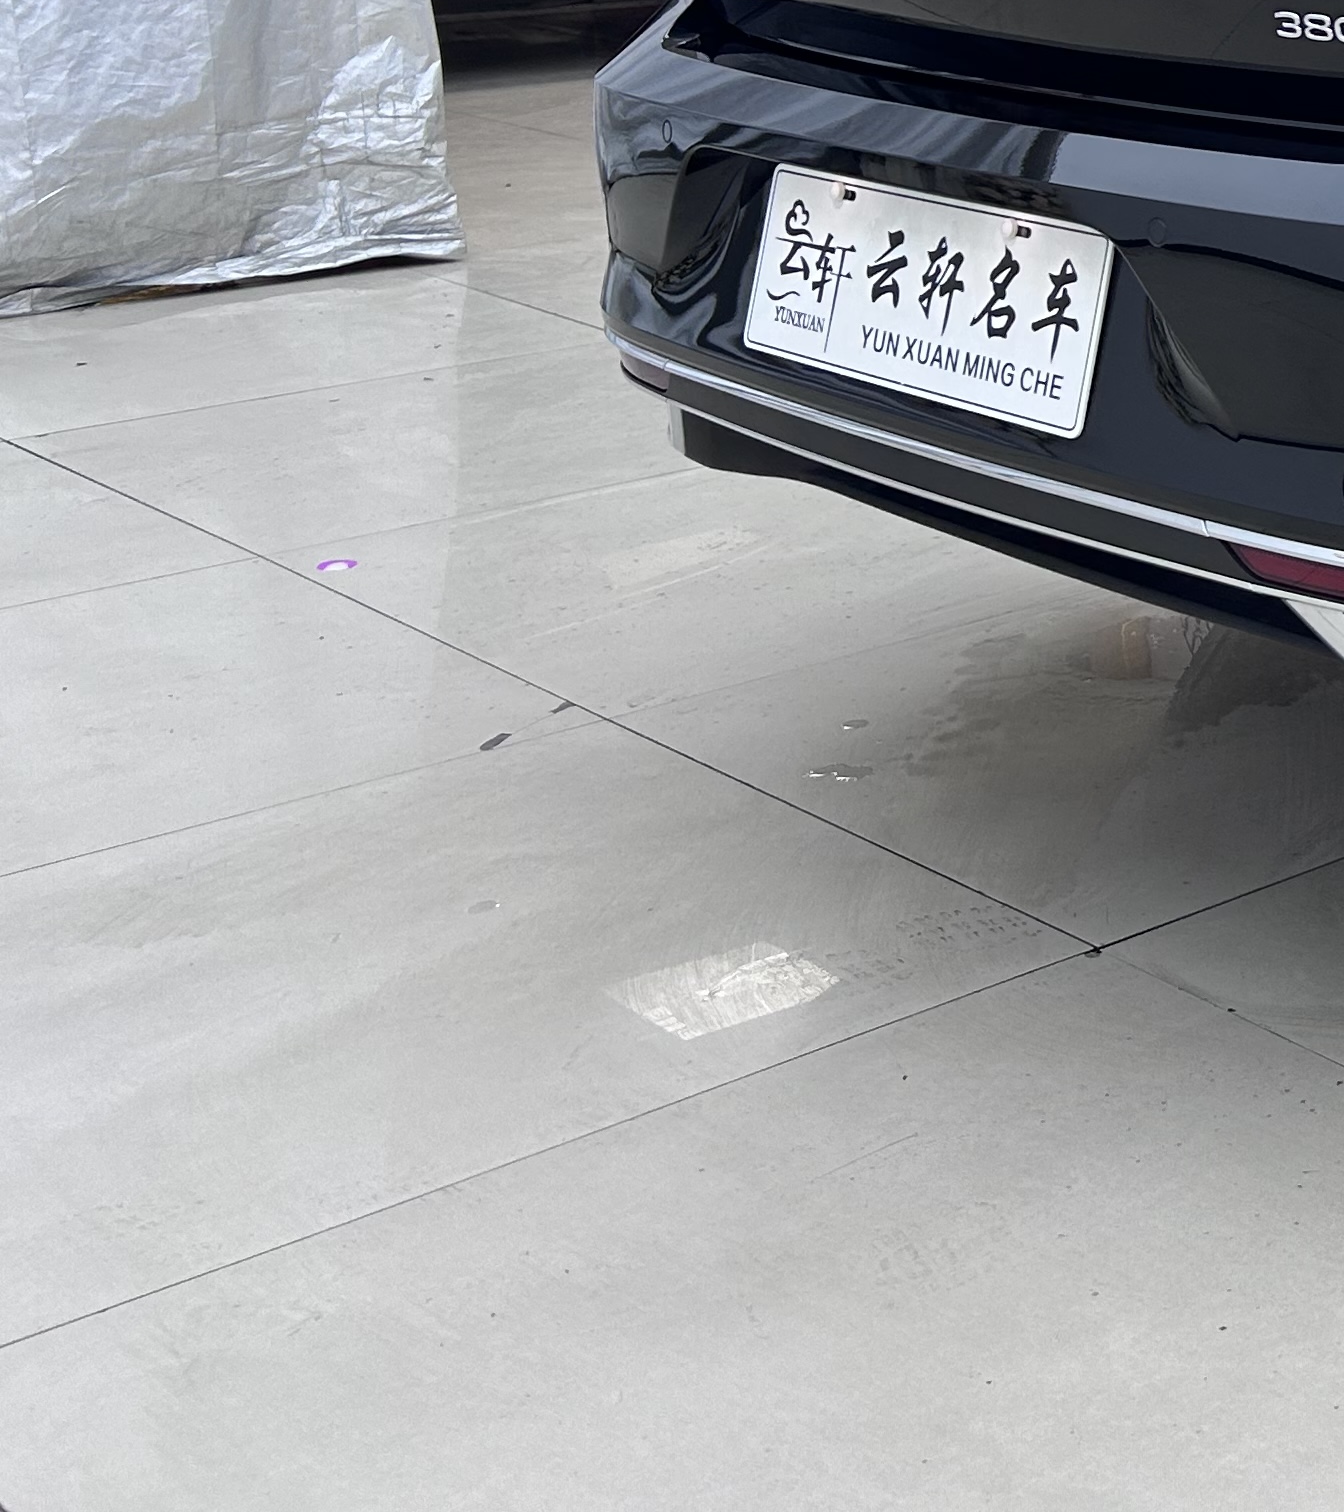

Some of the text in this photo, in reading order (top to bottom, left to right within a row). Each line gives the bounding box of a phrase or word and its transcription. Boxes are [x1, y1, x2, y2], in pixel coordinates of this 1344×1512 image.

[774, 305, 826, 334] YUNXUAN
[866, 229, 1080, 363] 云轩名车
[861, 324, 1065, 401] YUN XUAN MING CHE
